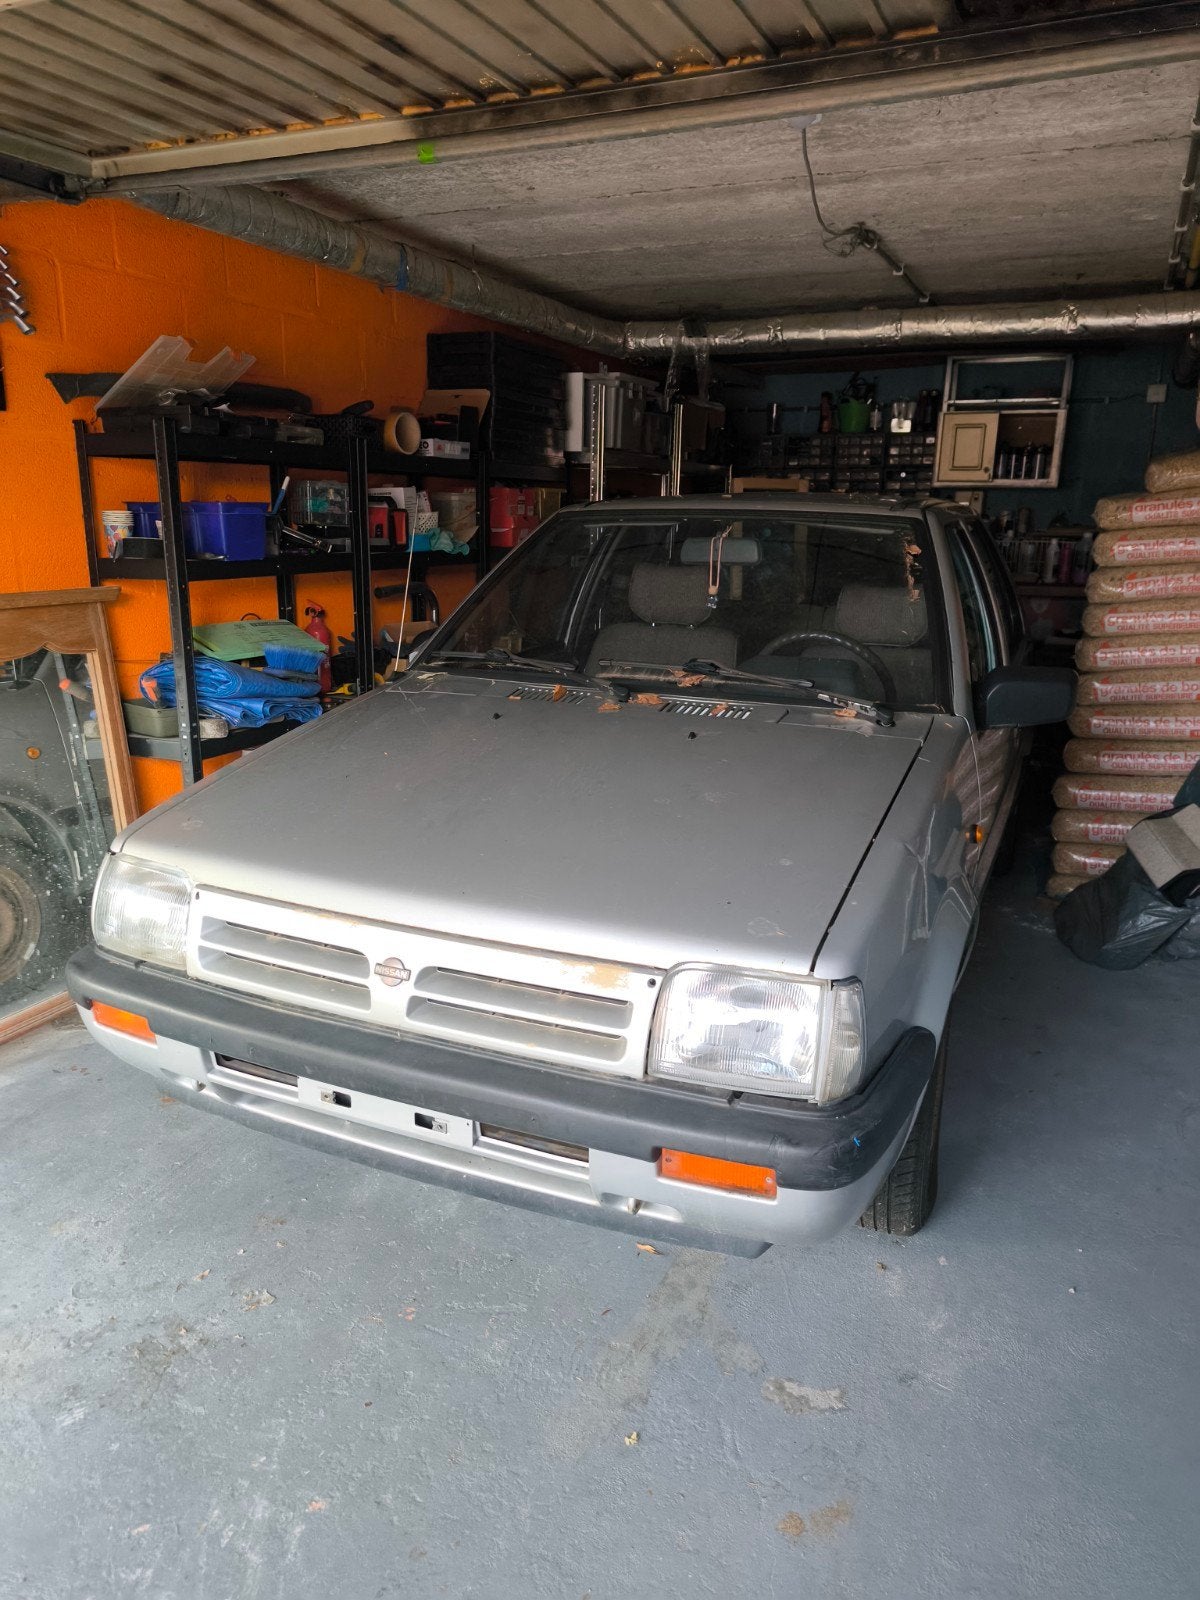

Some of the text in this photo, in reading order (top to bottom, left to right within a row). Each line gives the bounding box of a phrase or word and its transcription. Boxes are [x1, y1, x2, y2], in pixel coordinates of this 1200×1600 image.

[1159, 646, 1176, 656] de
[1161, 681, 1177, 692] de
[1154, 717, 1170, 727] de
[1163, 752, 1180, 763] de
[1140, 793, 1157, 804] de
[375, 965, 410, 980] NISSAN
